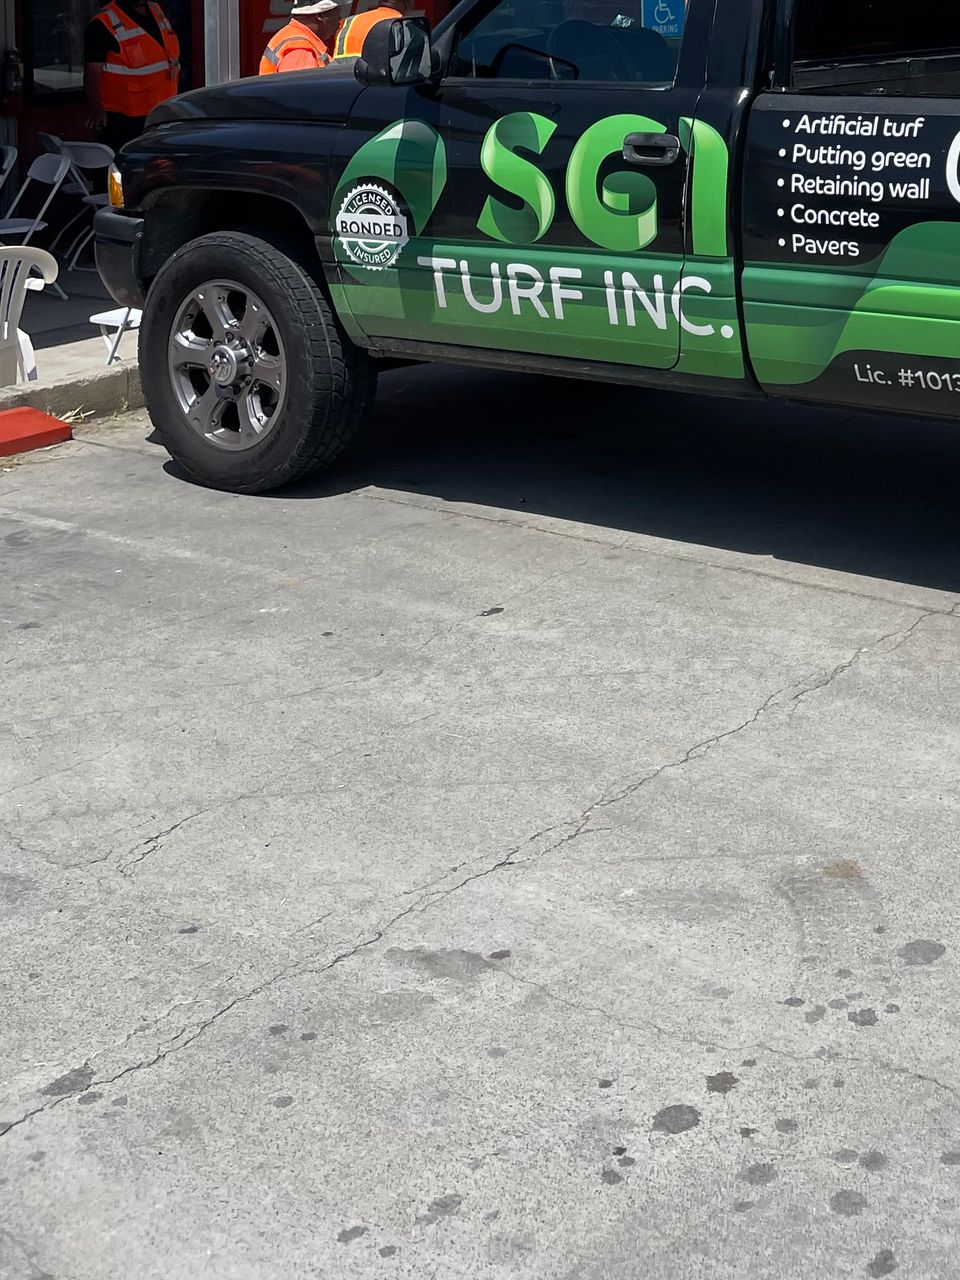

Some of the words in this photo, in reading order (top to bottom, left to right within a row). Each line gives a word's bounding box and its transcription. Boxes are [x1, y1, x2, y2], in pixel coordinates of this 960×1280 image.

[795, 114, 880, 136] Artificial
[882, 117, 926, 138] turf
[792, 143, 867, 171] Putting
[871, 150, 931, 172] green
[476, 111, 729, 257] SGI
[790, 173, 884, 202] Retaining
[888, 177, 930, 200] wall
[347, 192, 393, 216] LICENSED
[790, 203, 880, 228] Concrete
[340, 220, 403, 238] BONDED
[353, 246, 391, 264] INSURED
[791, 233, 860, 257] Pavers
[417, 256, 583, 320] TURF
[604, 270, 735, 339] INC.
[853, 363, 893, 386] Lic.
